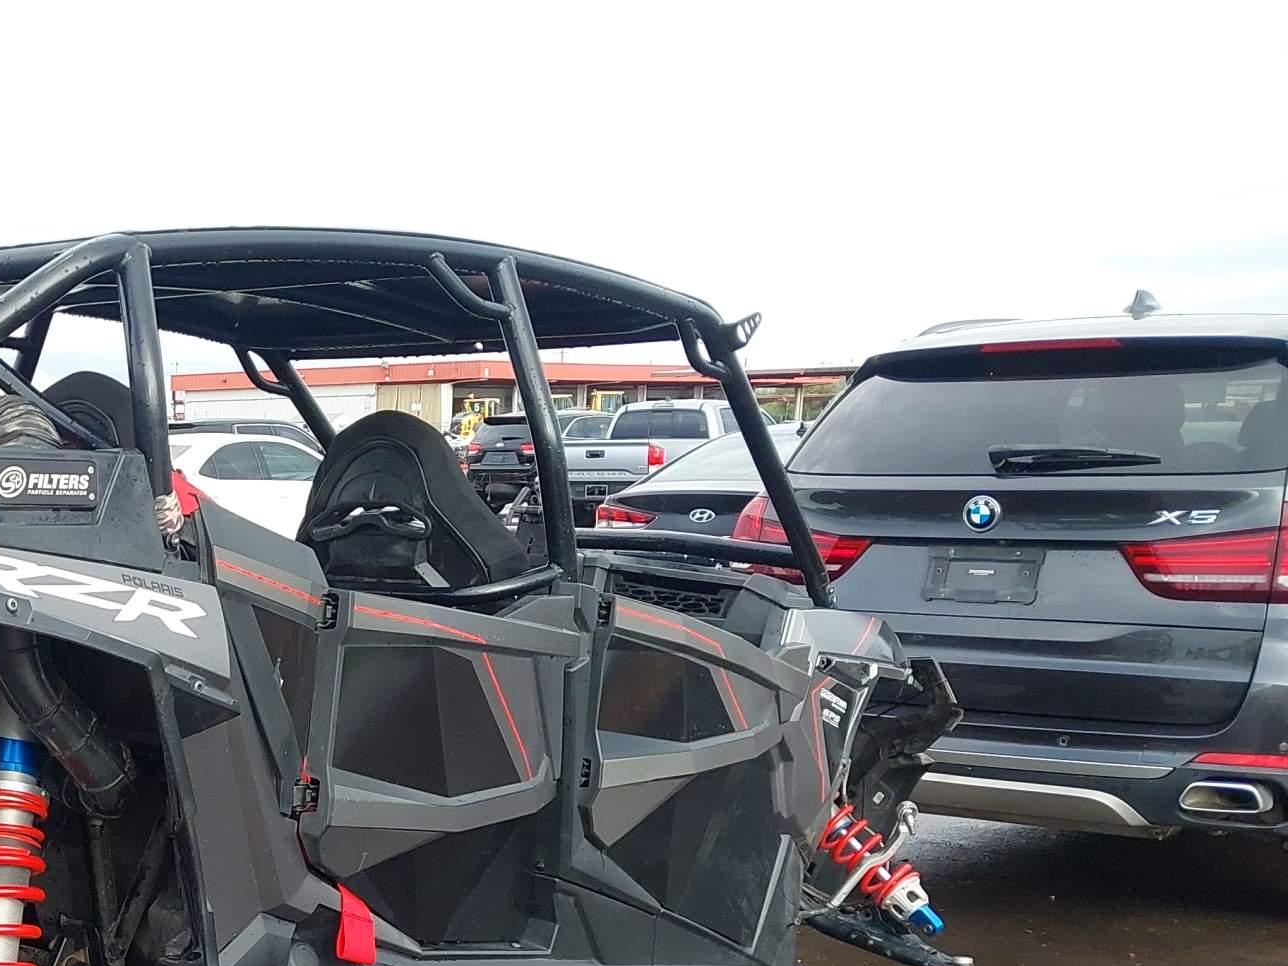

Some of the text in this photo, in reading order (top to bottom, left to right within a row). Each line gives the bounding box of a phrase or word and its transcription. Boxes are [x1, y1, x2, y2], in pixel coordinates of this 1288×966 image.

[28, 473, 90, 490] FILTERS
[1146, 509, 1221, 526] X5
[120, 572, 185, 599] POLARIS
